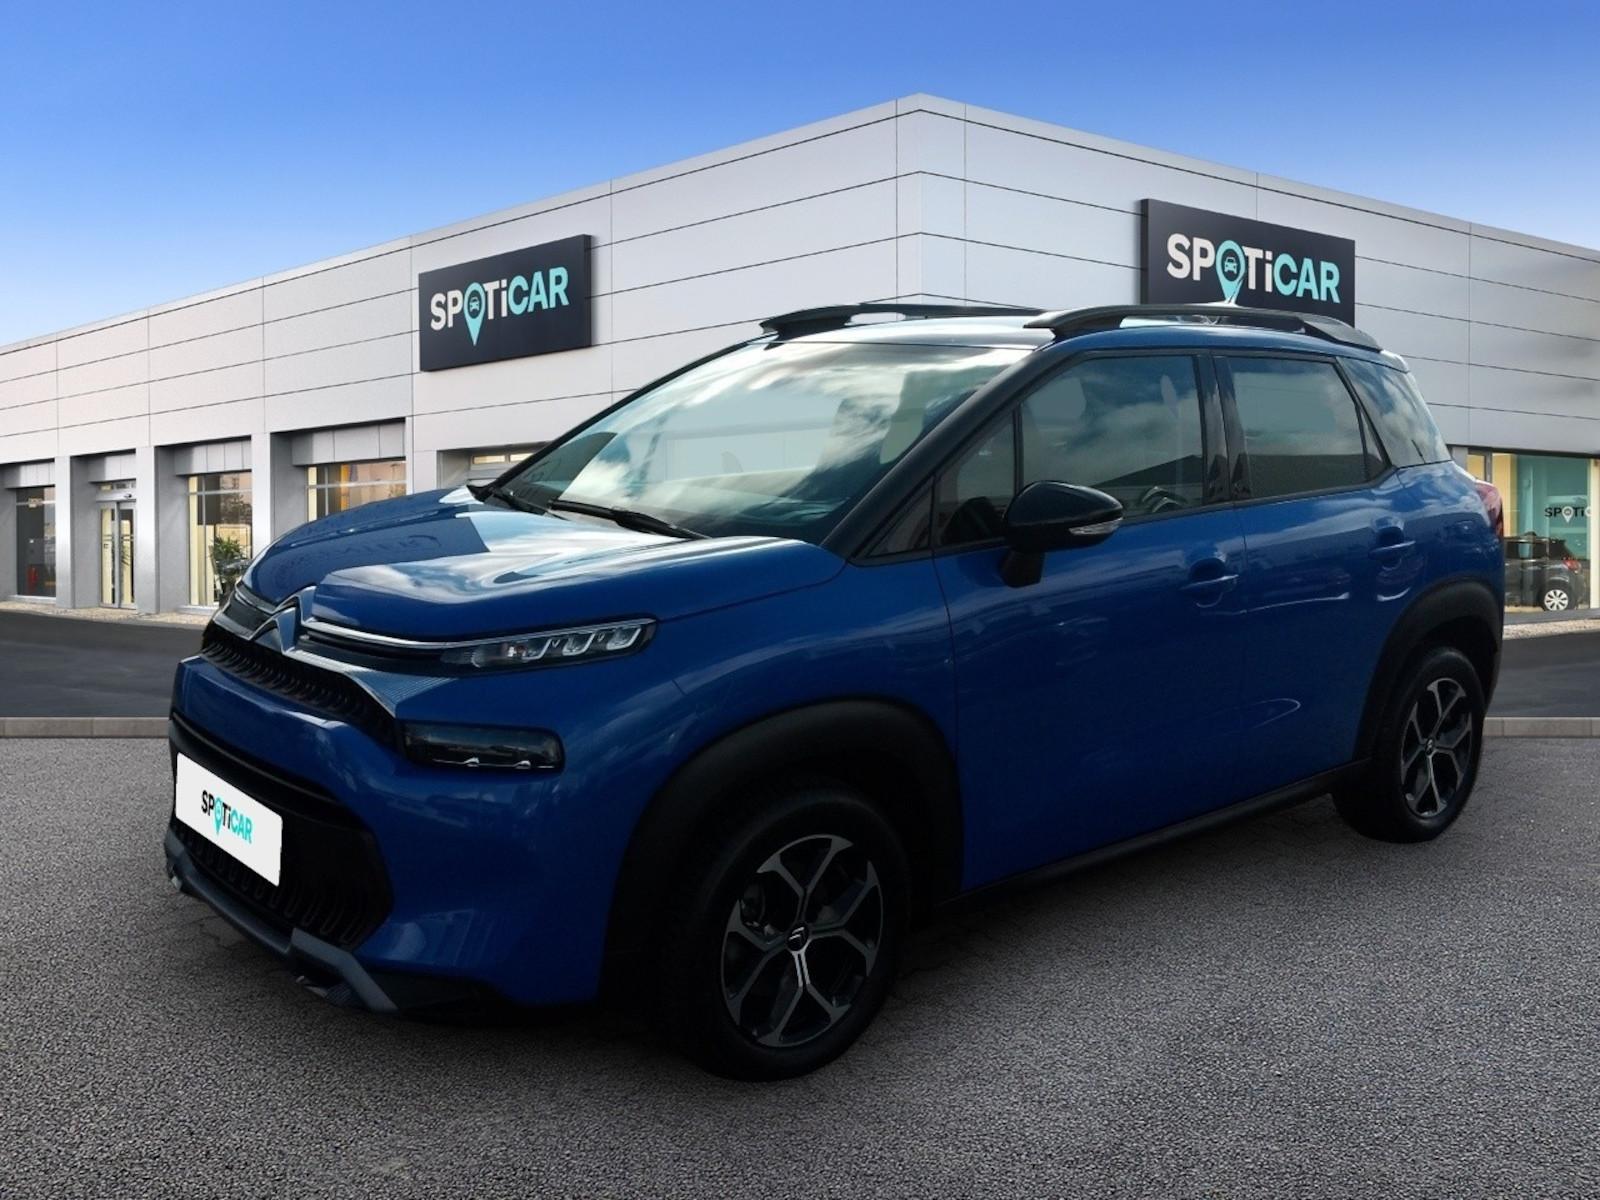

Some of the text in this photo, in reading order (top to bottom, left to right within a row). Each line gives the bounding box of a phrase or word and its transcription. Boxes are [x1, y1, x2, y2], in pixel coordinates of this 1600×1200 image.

[1166, 233, 1340, 304] SPOTiCAR
[430, 266, 570, 346] SPOTiCAR
[201, 789, 252, 844] SPOTiCAR
